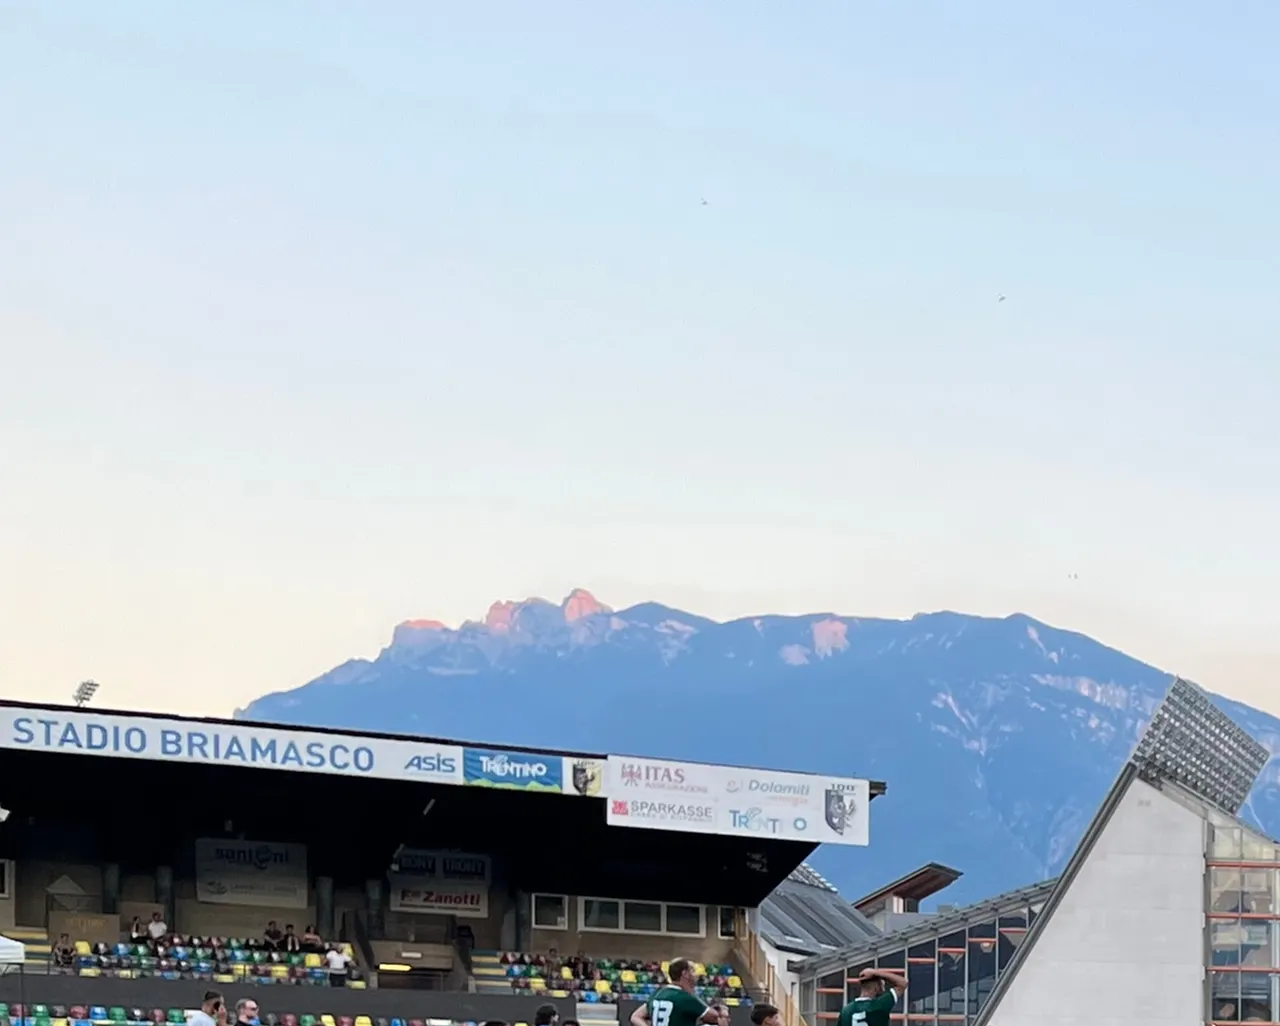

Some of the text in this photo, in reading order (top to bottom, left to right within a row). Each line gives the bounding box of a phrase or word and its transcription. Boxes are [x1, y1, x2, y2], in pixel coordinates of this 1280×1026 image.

[13, 717, 375, 772] STADIO BRIAMASCO
[479, 754, 548, 778] TRENTINO
[644, 765, 686, 784] ITAS
[749, 779, 811, 796] Dolomiti
[631, 800, 713, 819] SPARKASSE
[422, 890, 481, 906] Zanotti
